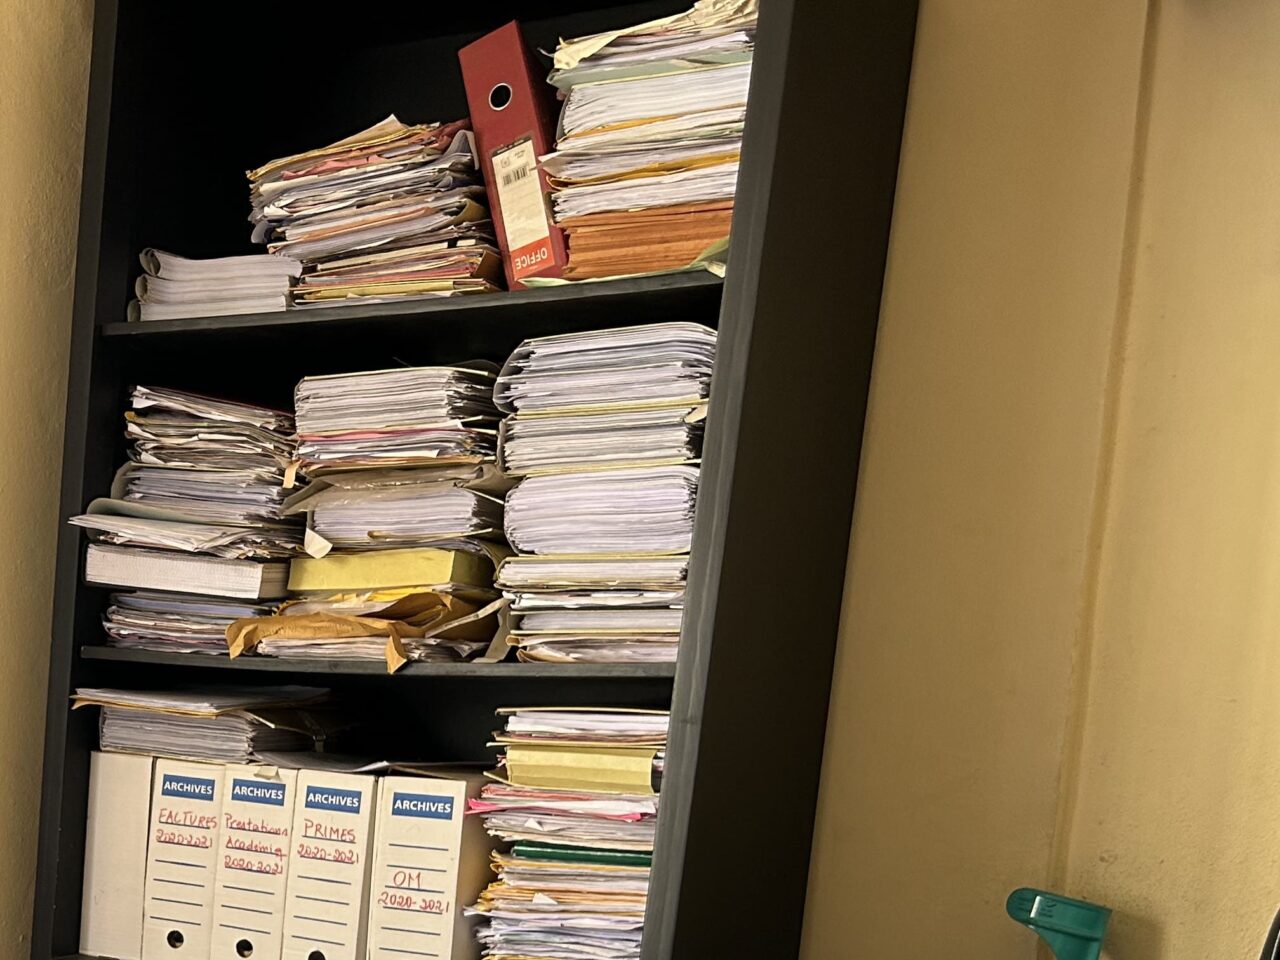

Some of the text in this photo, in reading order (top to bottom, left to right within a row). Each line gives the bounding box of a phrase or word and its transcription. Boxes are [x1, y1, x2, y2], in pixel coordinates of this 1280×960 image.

[514, 247, 548, 270] OFFICE
[163, 781, 213, 795] ARCHIVES
[233, 785, 283, 799] ARCHIVES
[307, 793, 359, 808] ARCHIVES
[394, 799, 452, 813] ARCHIVES
[304, 818, 356, 842] PRIMES
[297, 843, 359, 865] 2020-2021
[393, 870, 421, 889] OM
